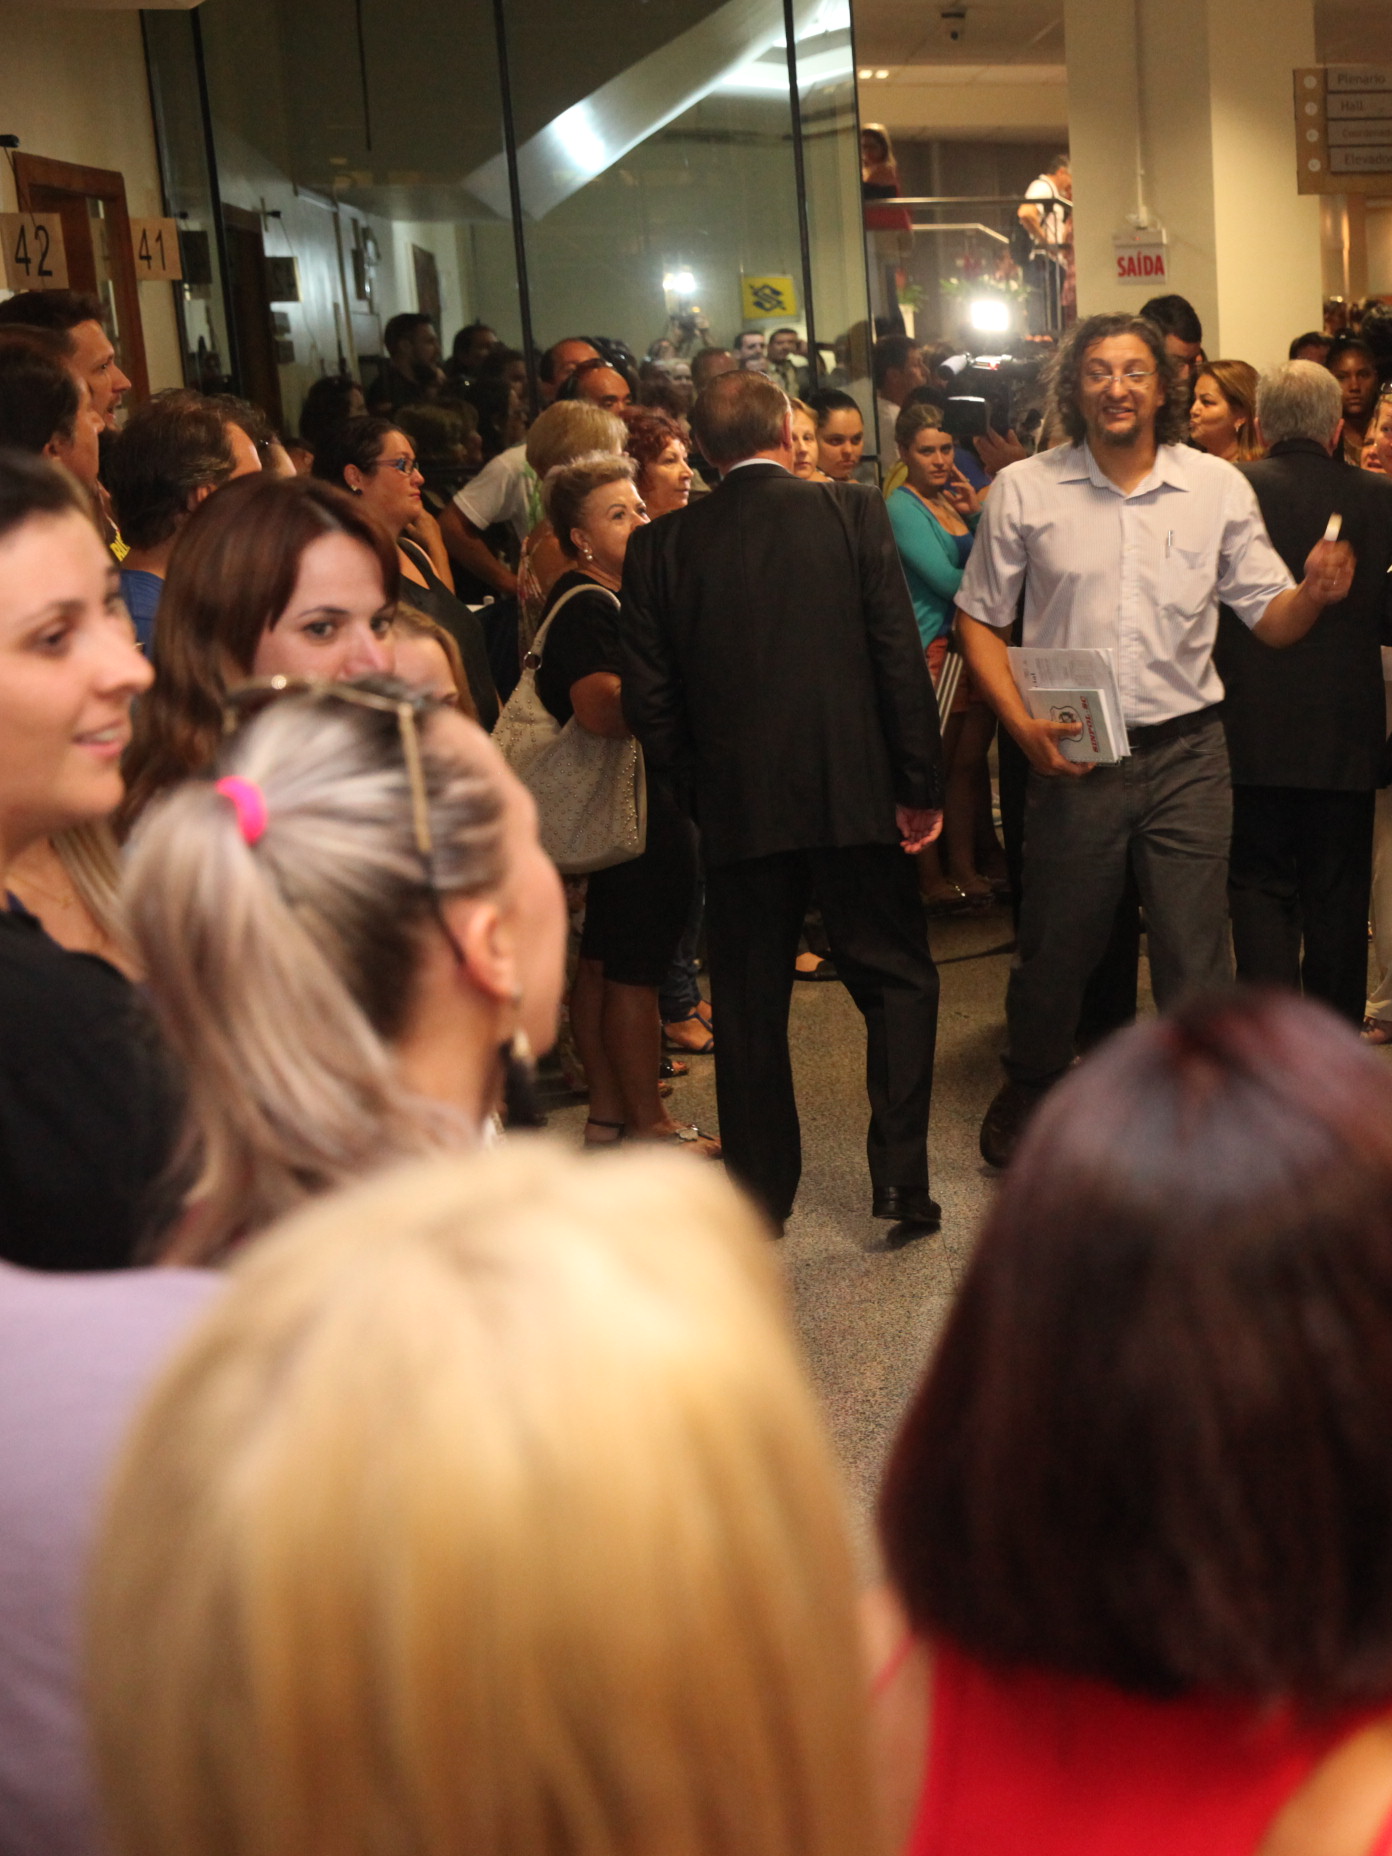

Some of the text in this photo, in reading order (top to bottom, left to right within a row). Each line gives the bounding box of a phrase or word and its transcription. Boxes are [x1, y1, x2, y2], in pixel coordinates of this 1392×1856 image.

[1341, 101, 1363, 112] Hall
[15, 224, 53, 277] 42
[138, 228, 166, 271] 41
[1116, 250, 1165, 278] SAÍDA
